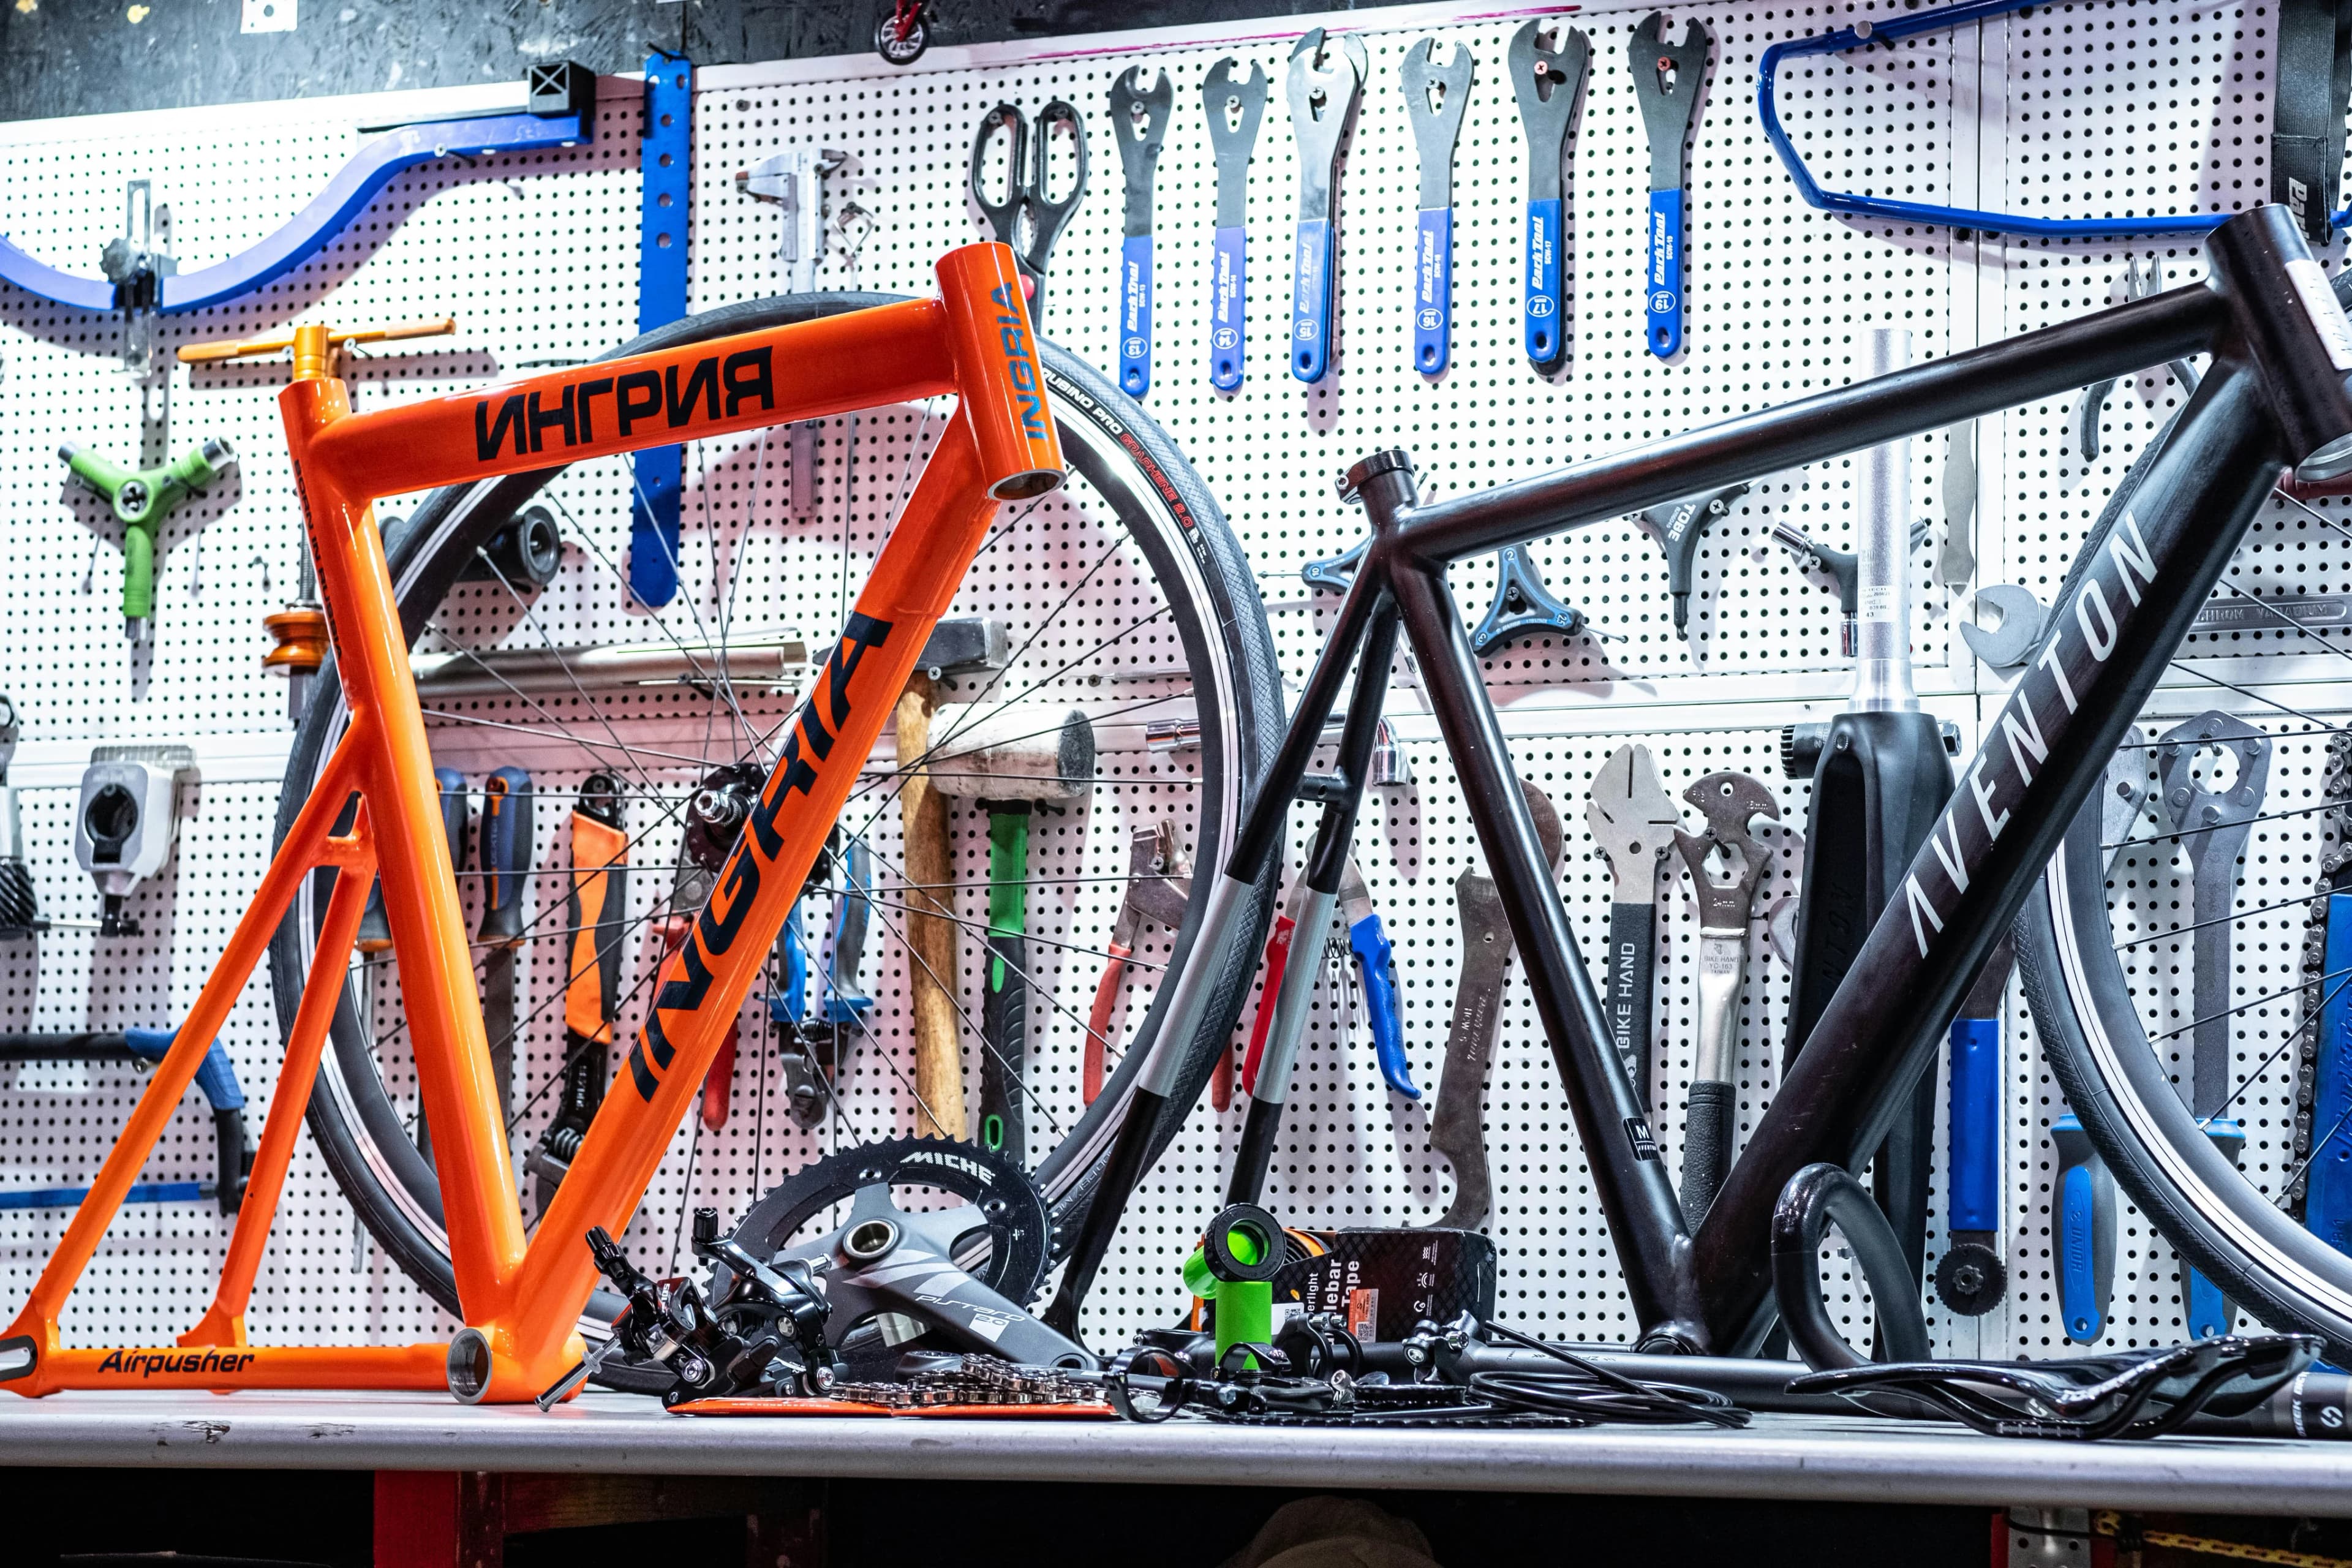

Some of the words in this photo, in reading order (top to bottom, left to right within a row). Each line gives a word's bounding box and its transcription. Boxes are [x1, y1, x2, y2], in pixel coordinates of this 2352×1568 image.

[1532, 216, 1544, 252] Tool
[1655, 211, 1666, 248] Tool
[1300, 243, 1313, 276] Tool
[1422, 230, 1434, 266] Tool
[1654, 247, 1665, 285] Park
[1128, 260, 1139, 295] Tool
[1218, 251, 1230, 285] Tool
[1422, 266, 1433, 303] Park
[1532, 252, 1543, 290] Park
[1217, 287, 1229, 323] Park
[1298, 277, 1311, 314] Park
[1532, 303, 1547, 314] 17
[1655, 300, 1669, 310] 19
[1126, 296, 1138, 332] Park
[1299, 326, 1311, 337] 15
[1423, 317, 1436, 327] 16
[1128, 345, 1142, 355] 13
[1218, 335, 1232, 346] 14
[991, 281, 1049, 440] INGRIA
[476, 345, 774, 461] ИНГРИЯ
[1042, 367, 1095, 409] RUBINO
[1093, 405, 1123, 435] PRO
[1120, 433, 1178, 502] GRAPHENE
[1173, 502, 1193, 528] 2.0
[1668, 503, 1697, 542] TOBE
[294, 459, 314, 530] BORN
[312, 536, 321, 561] IN
[318, 568, 342, 661] RUSSIA
[1311, 567, 1319, 576] 10
[1507, 551, 1515, 561] 2
[1478, 634, 1487, 643] 3
[1906, 510, 2158, 960] AVENTON
[628, 612, 893, 1102] INGRIA
[1618, 943, 1635, 997] HAND
[1616, 1004, 1632, 1049] BIKE
[1635, 1125, 1649, 1139] M
[900, 1151, 995, 1186] MICHE
[1079, 1169, 1098, 1191] PSI
[2070, 1227, 2083, 1273] UNIOR
[1306, 1272, 1319, 1315] erlight
[1323, 1259, 1341, 1314] lebar
[975, 1314, 1006, 1327] 2.0
[98, 1350, 254, 1378] Airpusher
